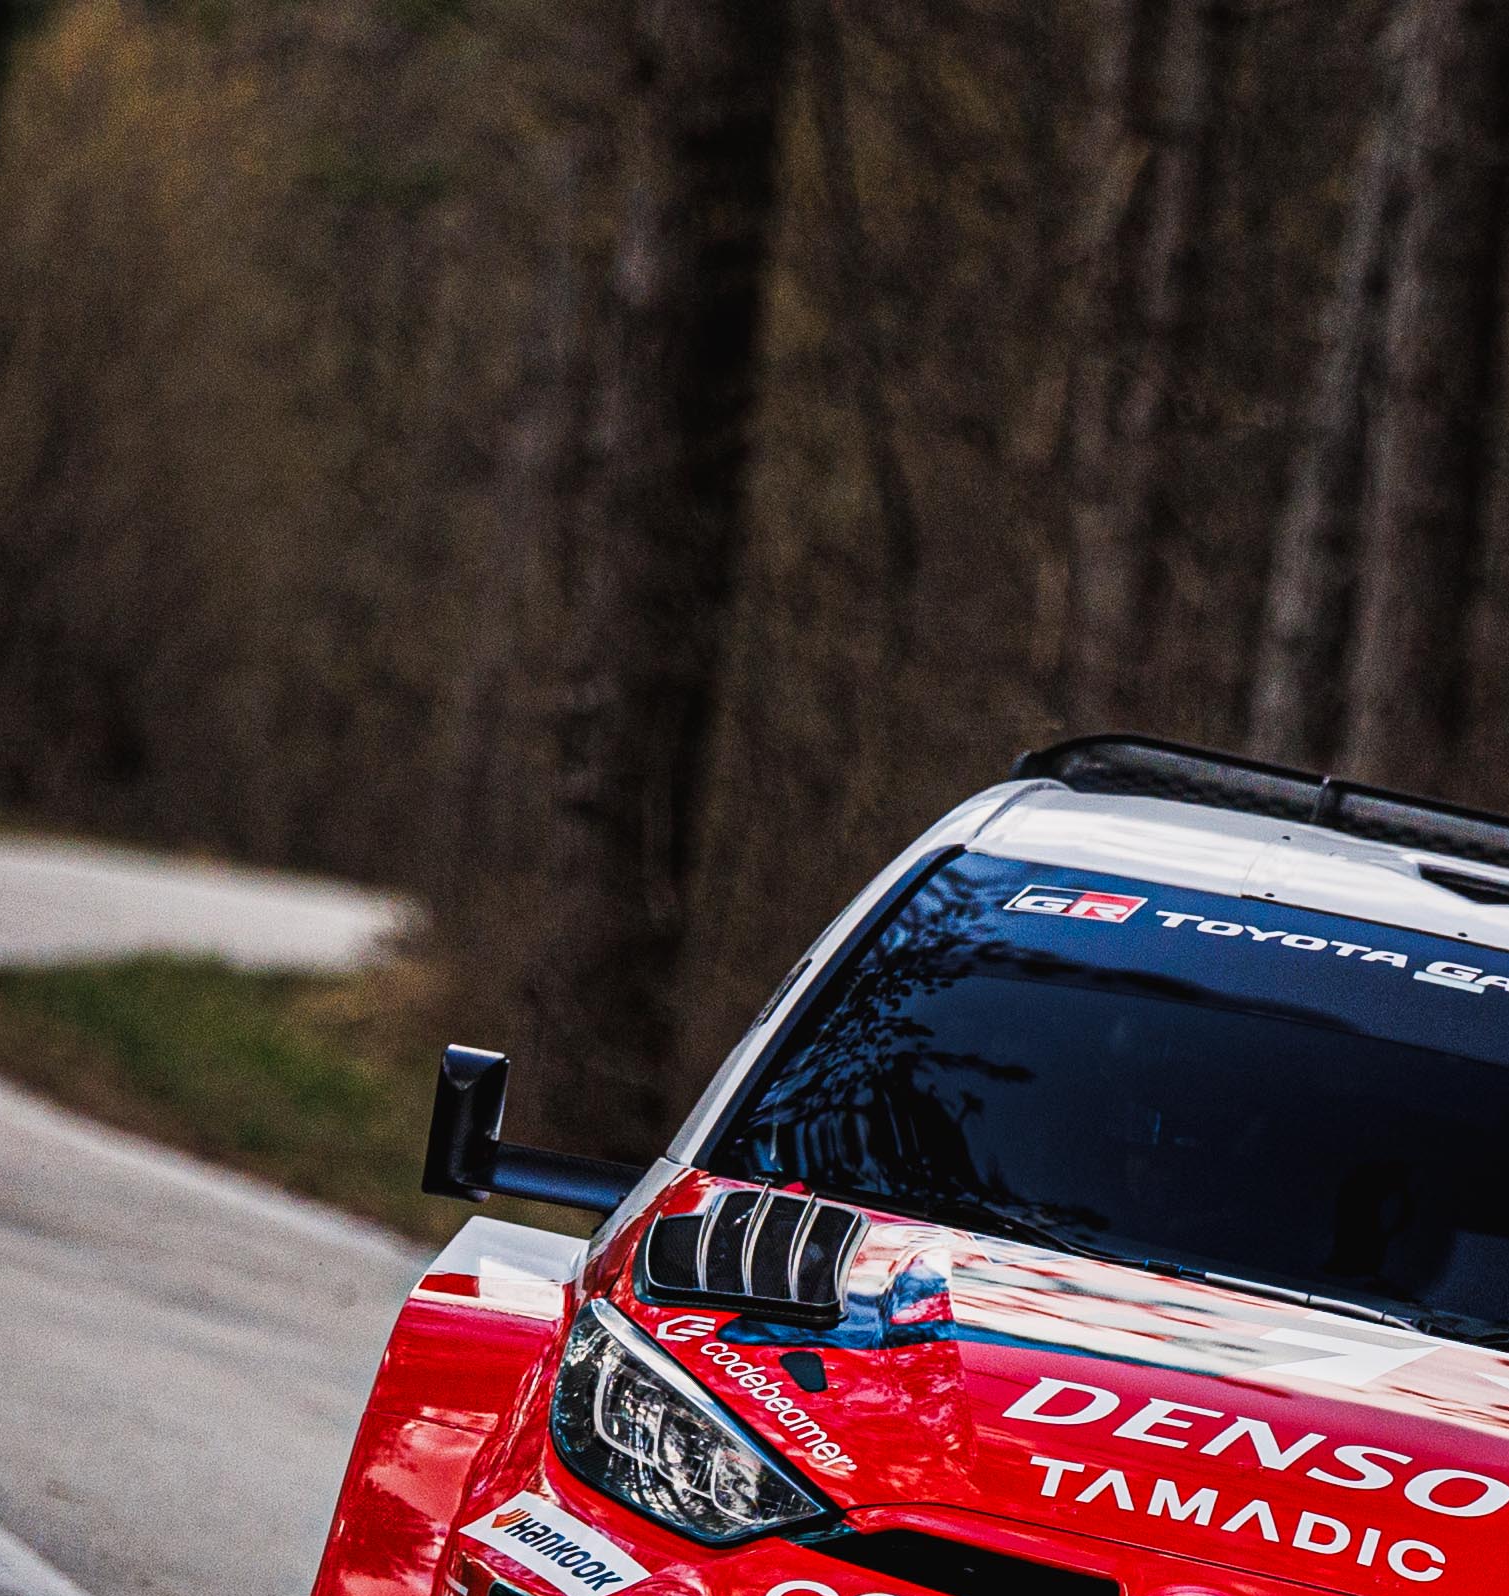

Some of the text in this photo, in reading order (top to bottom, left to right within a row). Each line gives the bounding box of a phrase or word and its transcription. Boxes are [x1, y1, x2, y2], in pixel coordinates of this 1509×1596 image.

[1014, 895, 1129, 922] GR
[1155, 910, 1408, 969] TOYOTA
[699, 1341, 854, 1468] codebeamer
[1029, 1455, 1447, 1583] TAMADIC
